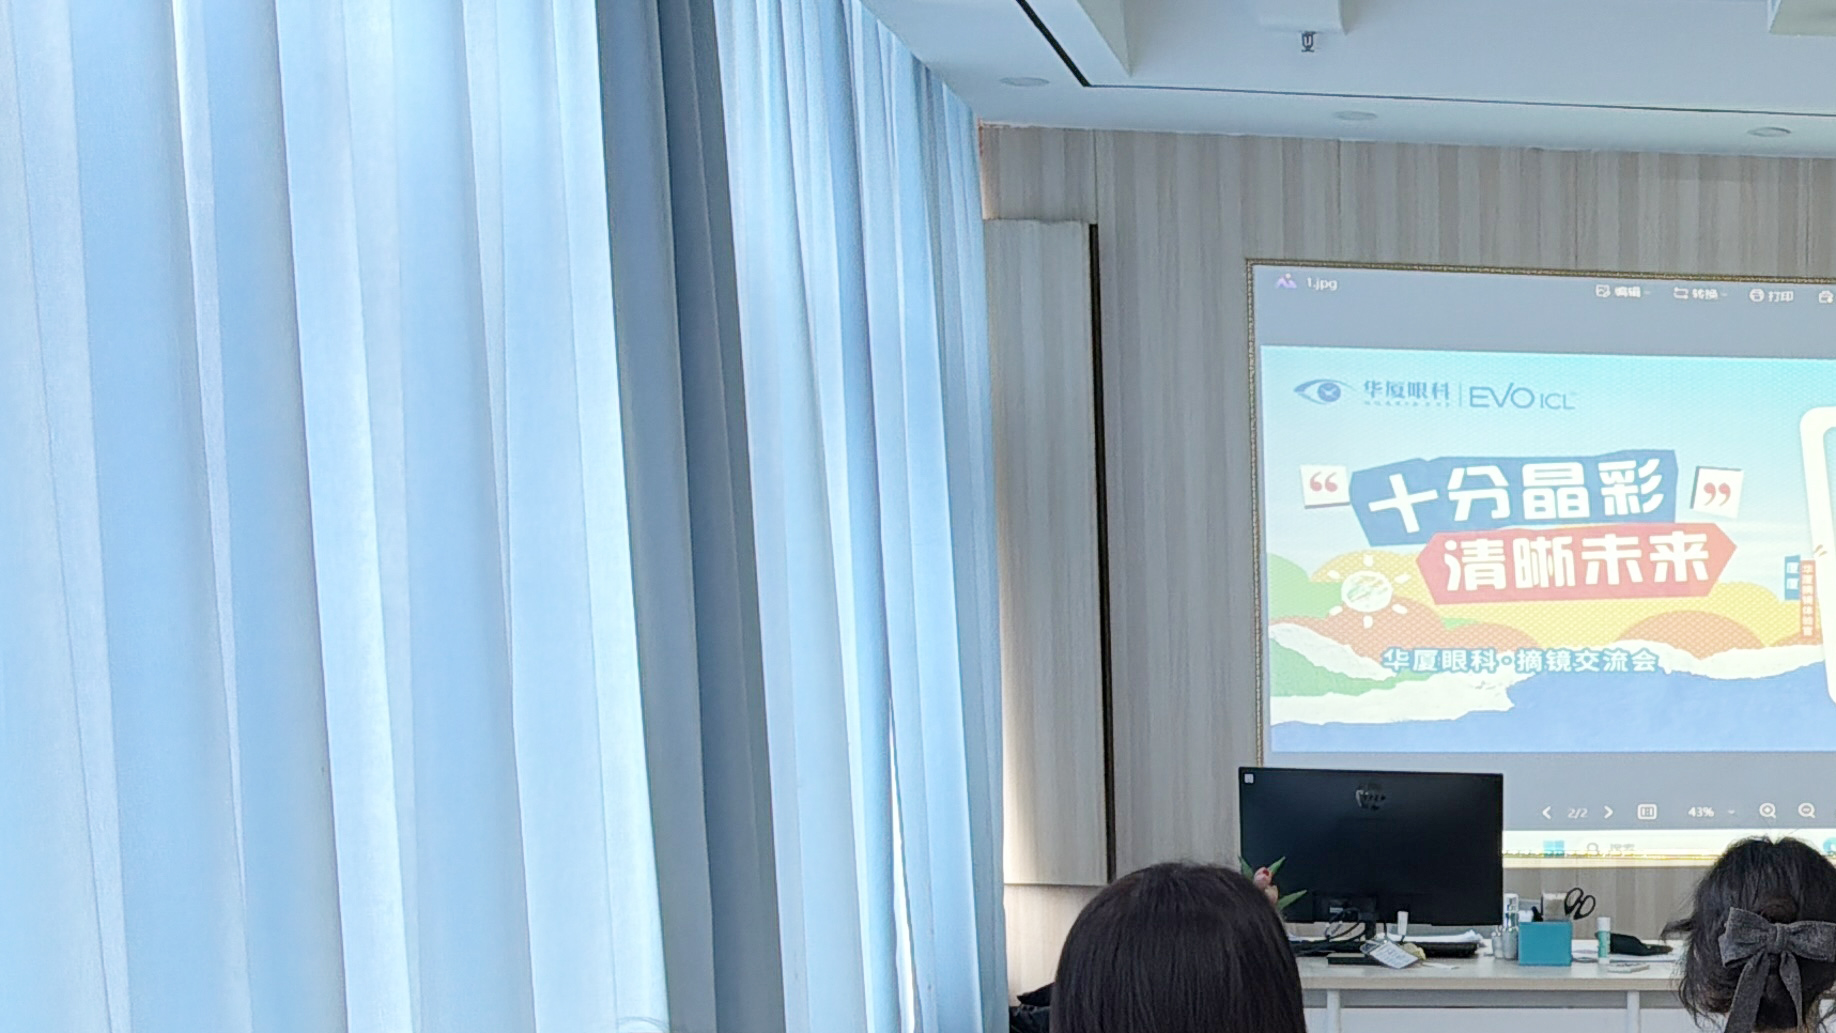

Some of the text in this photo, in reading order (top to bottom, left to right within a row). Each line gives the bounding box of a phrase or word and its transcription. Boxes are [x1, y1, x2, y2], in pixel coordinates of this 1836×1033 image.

[1306, 277, 1338, 290] 1.jpg
[1768, 290, 1794, 303] 打印
[1363, 379, 1450, 399] 华厦眼科
[1469, 382, 1576, 410] EVO ICL
[1368, 457, 1664, 534] 十分晶彩
[1443, 530, 1709, 592] 清晰未来
[1567, 806, 1588, 819] 2/2
[1688, 806, 1714, 818] 43%
